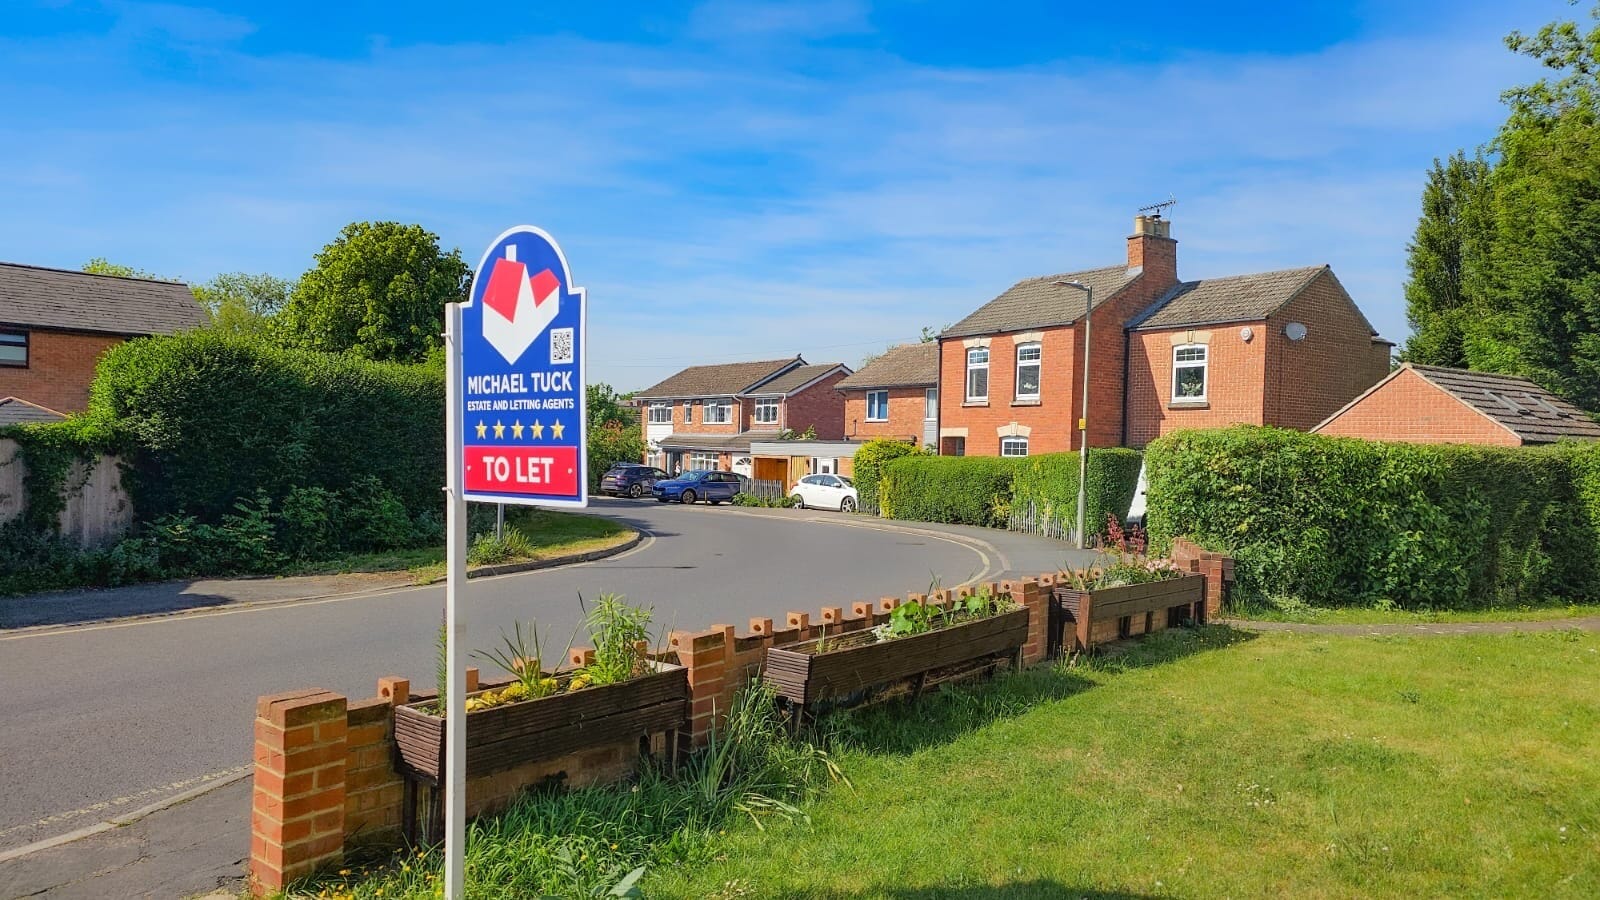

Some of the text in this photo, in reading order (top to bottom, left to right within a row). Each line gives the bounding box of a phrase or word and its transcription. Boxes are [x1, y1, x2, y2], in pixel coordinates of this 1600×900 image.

[467, 371, 573, 395] MICHAEL TUCK
[467, 398, 574, 412] ESTATE AND LETTING AGENTS
[482, 456, 554, 484] TO LET
